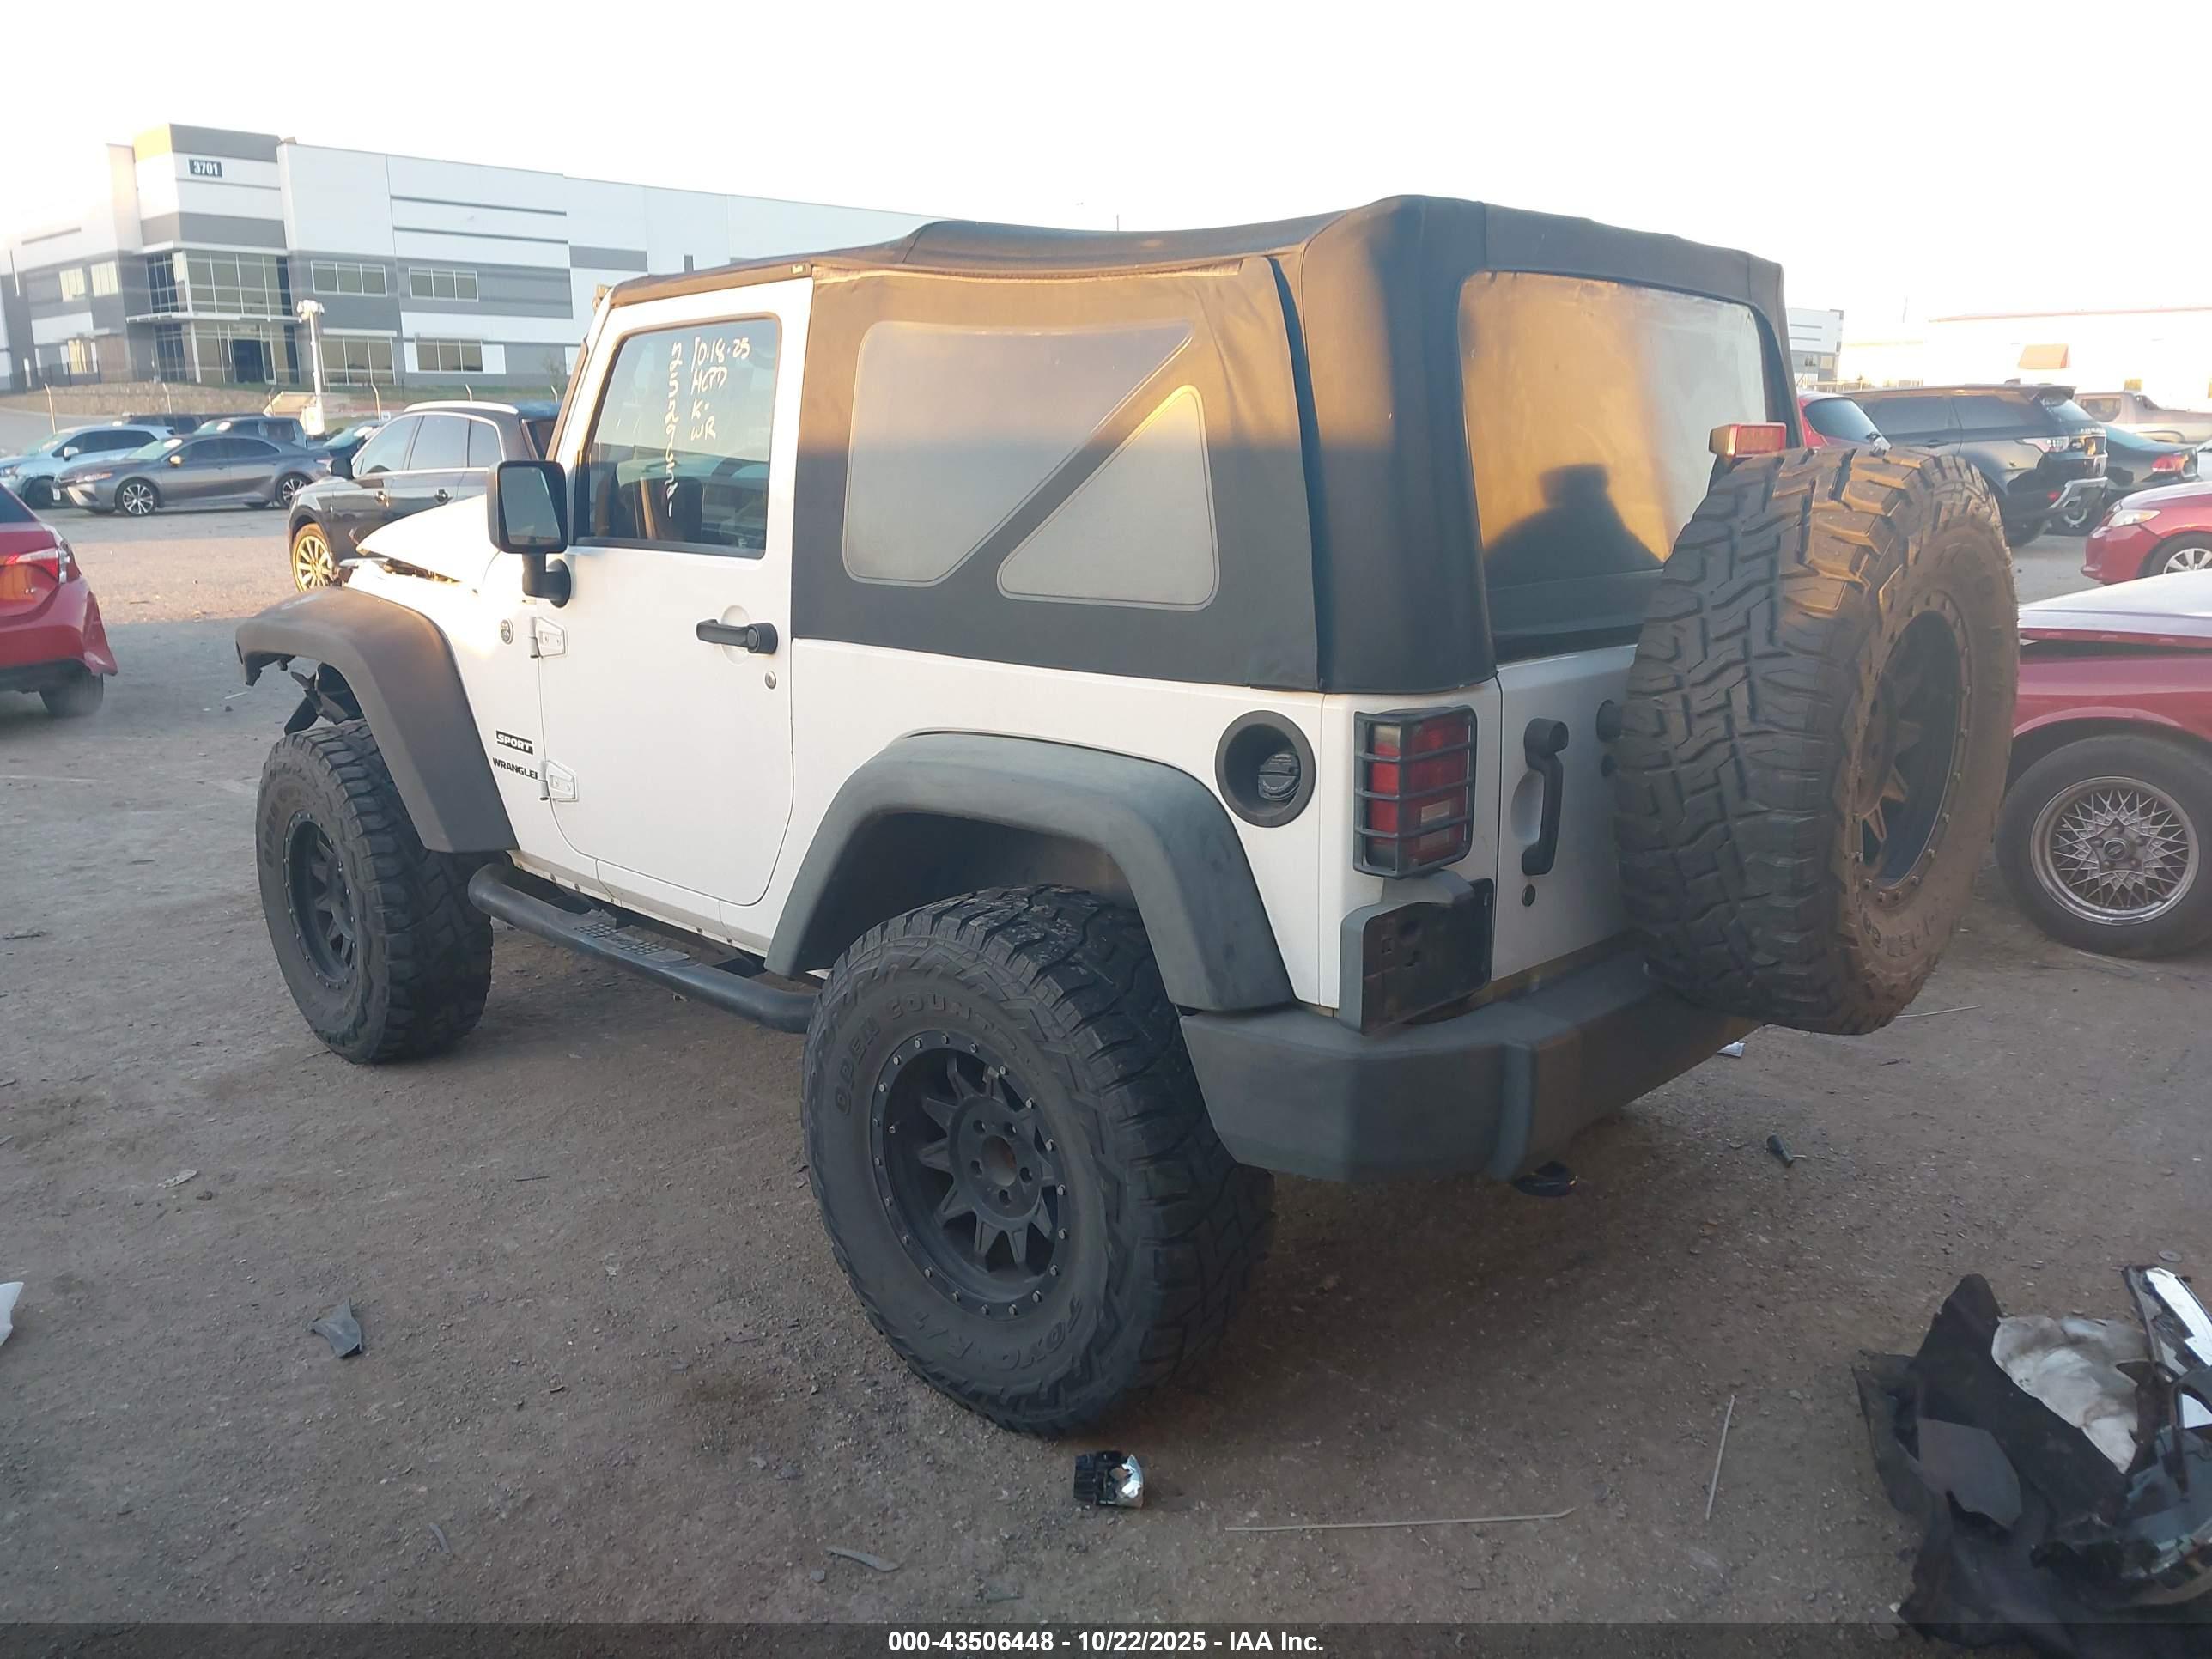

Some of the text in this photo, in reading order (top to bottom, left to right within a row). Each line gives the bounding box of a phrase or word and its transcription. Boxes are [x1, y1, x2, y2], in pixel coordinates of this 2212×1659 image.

[193, 160, 218, 176] 3701
[496, 732, 532, 753] SPORT
[492, 757, 539, 781] WRANGLER
